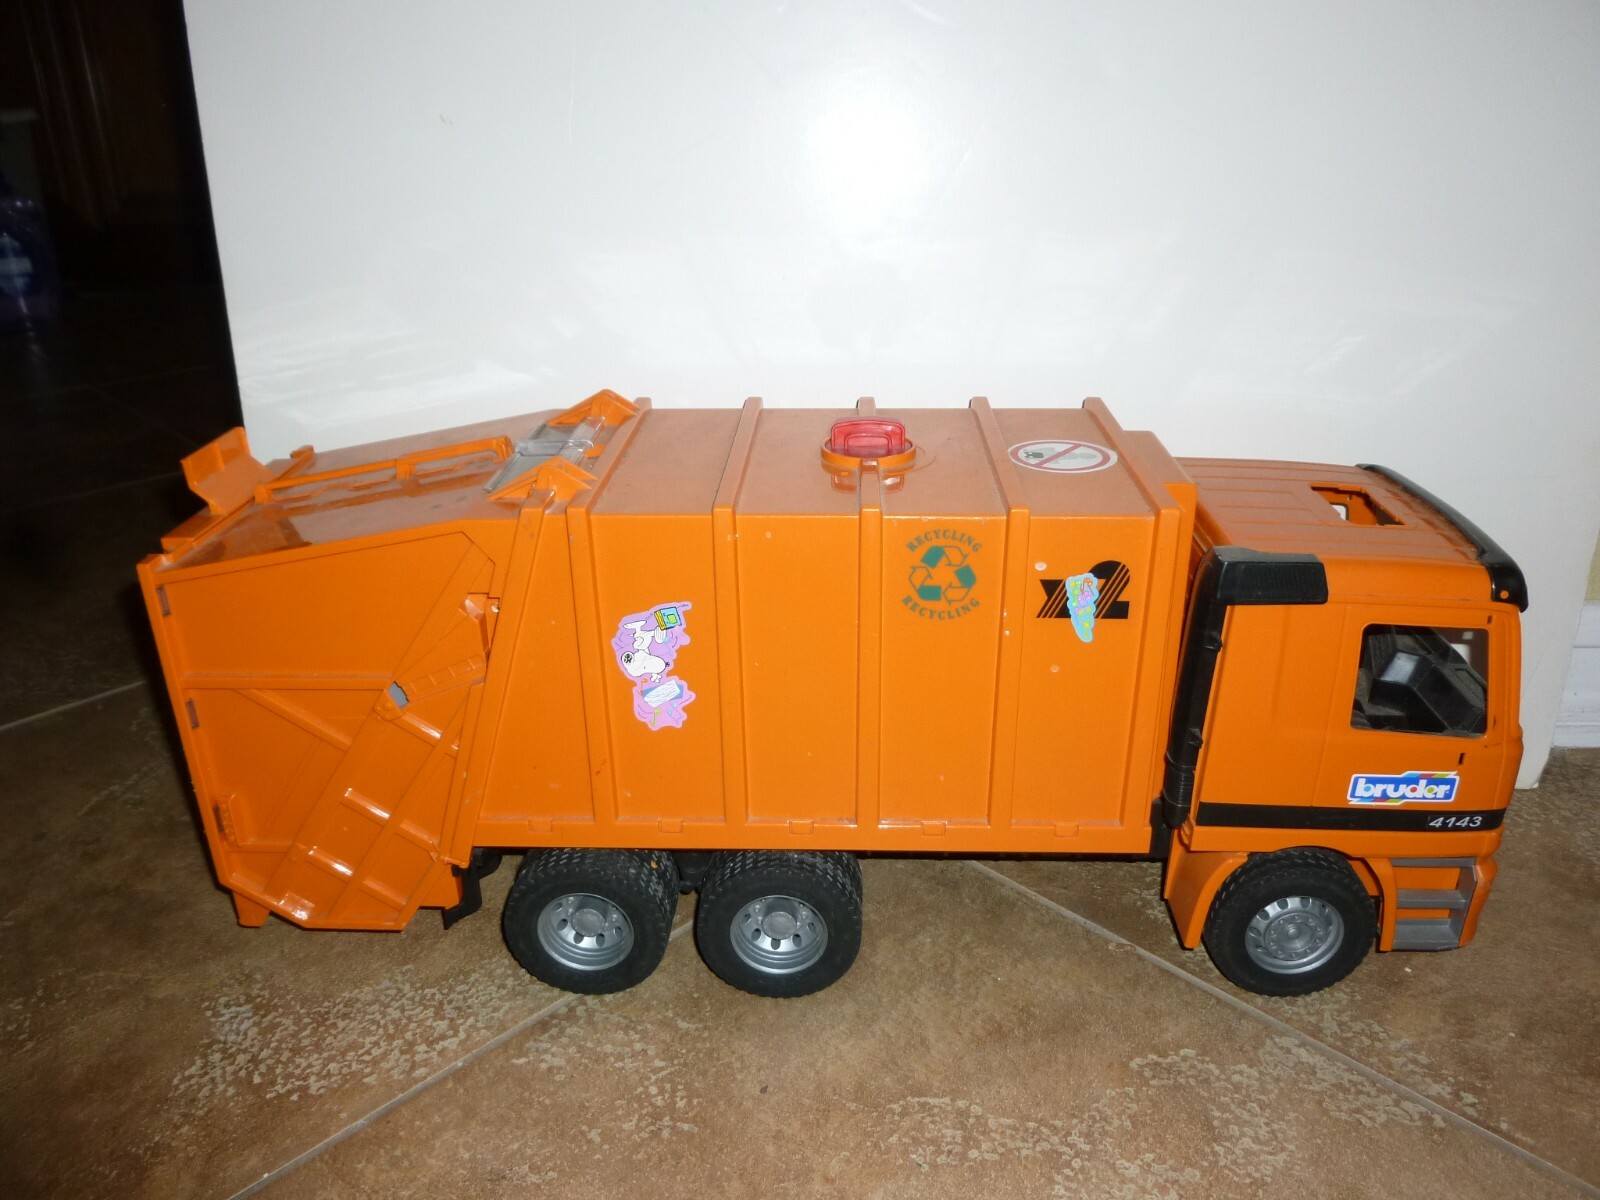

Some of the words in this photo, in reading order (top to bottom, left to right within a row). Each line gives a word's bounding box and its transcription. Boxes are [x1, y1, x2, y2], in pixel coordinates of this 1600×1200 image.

[906, 529, 982, 553] RECYCLING
[902, 596, 981, 621] RECYCLING
[1354, 777, 1451, 799] bruder
[1428, 816, 1483, 829] 4143
